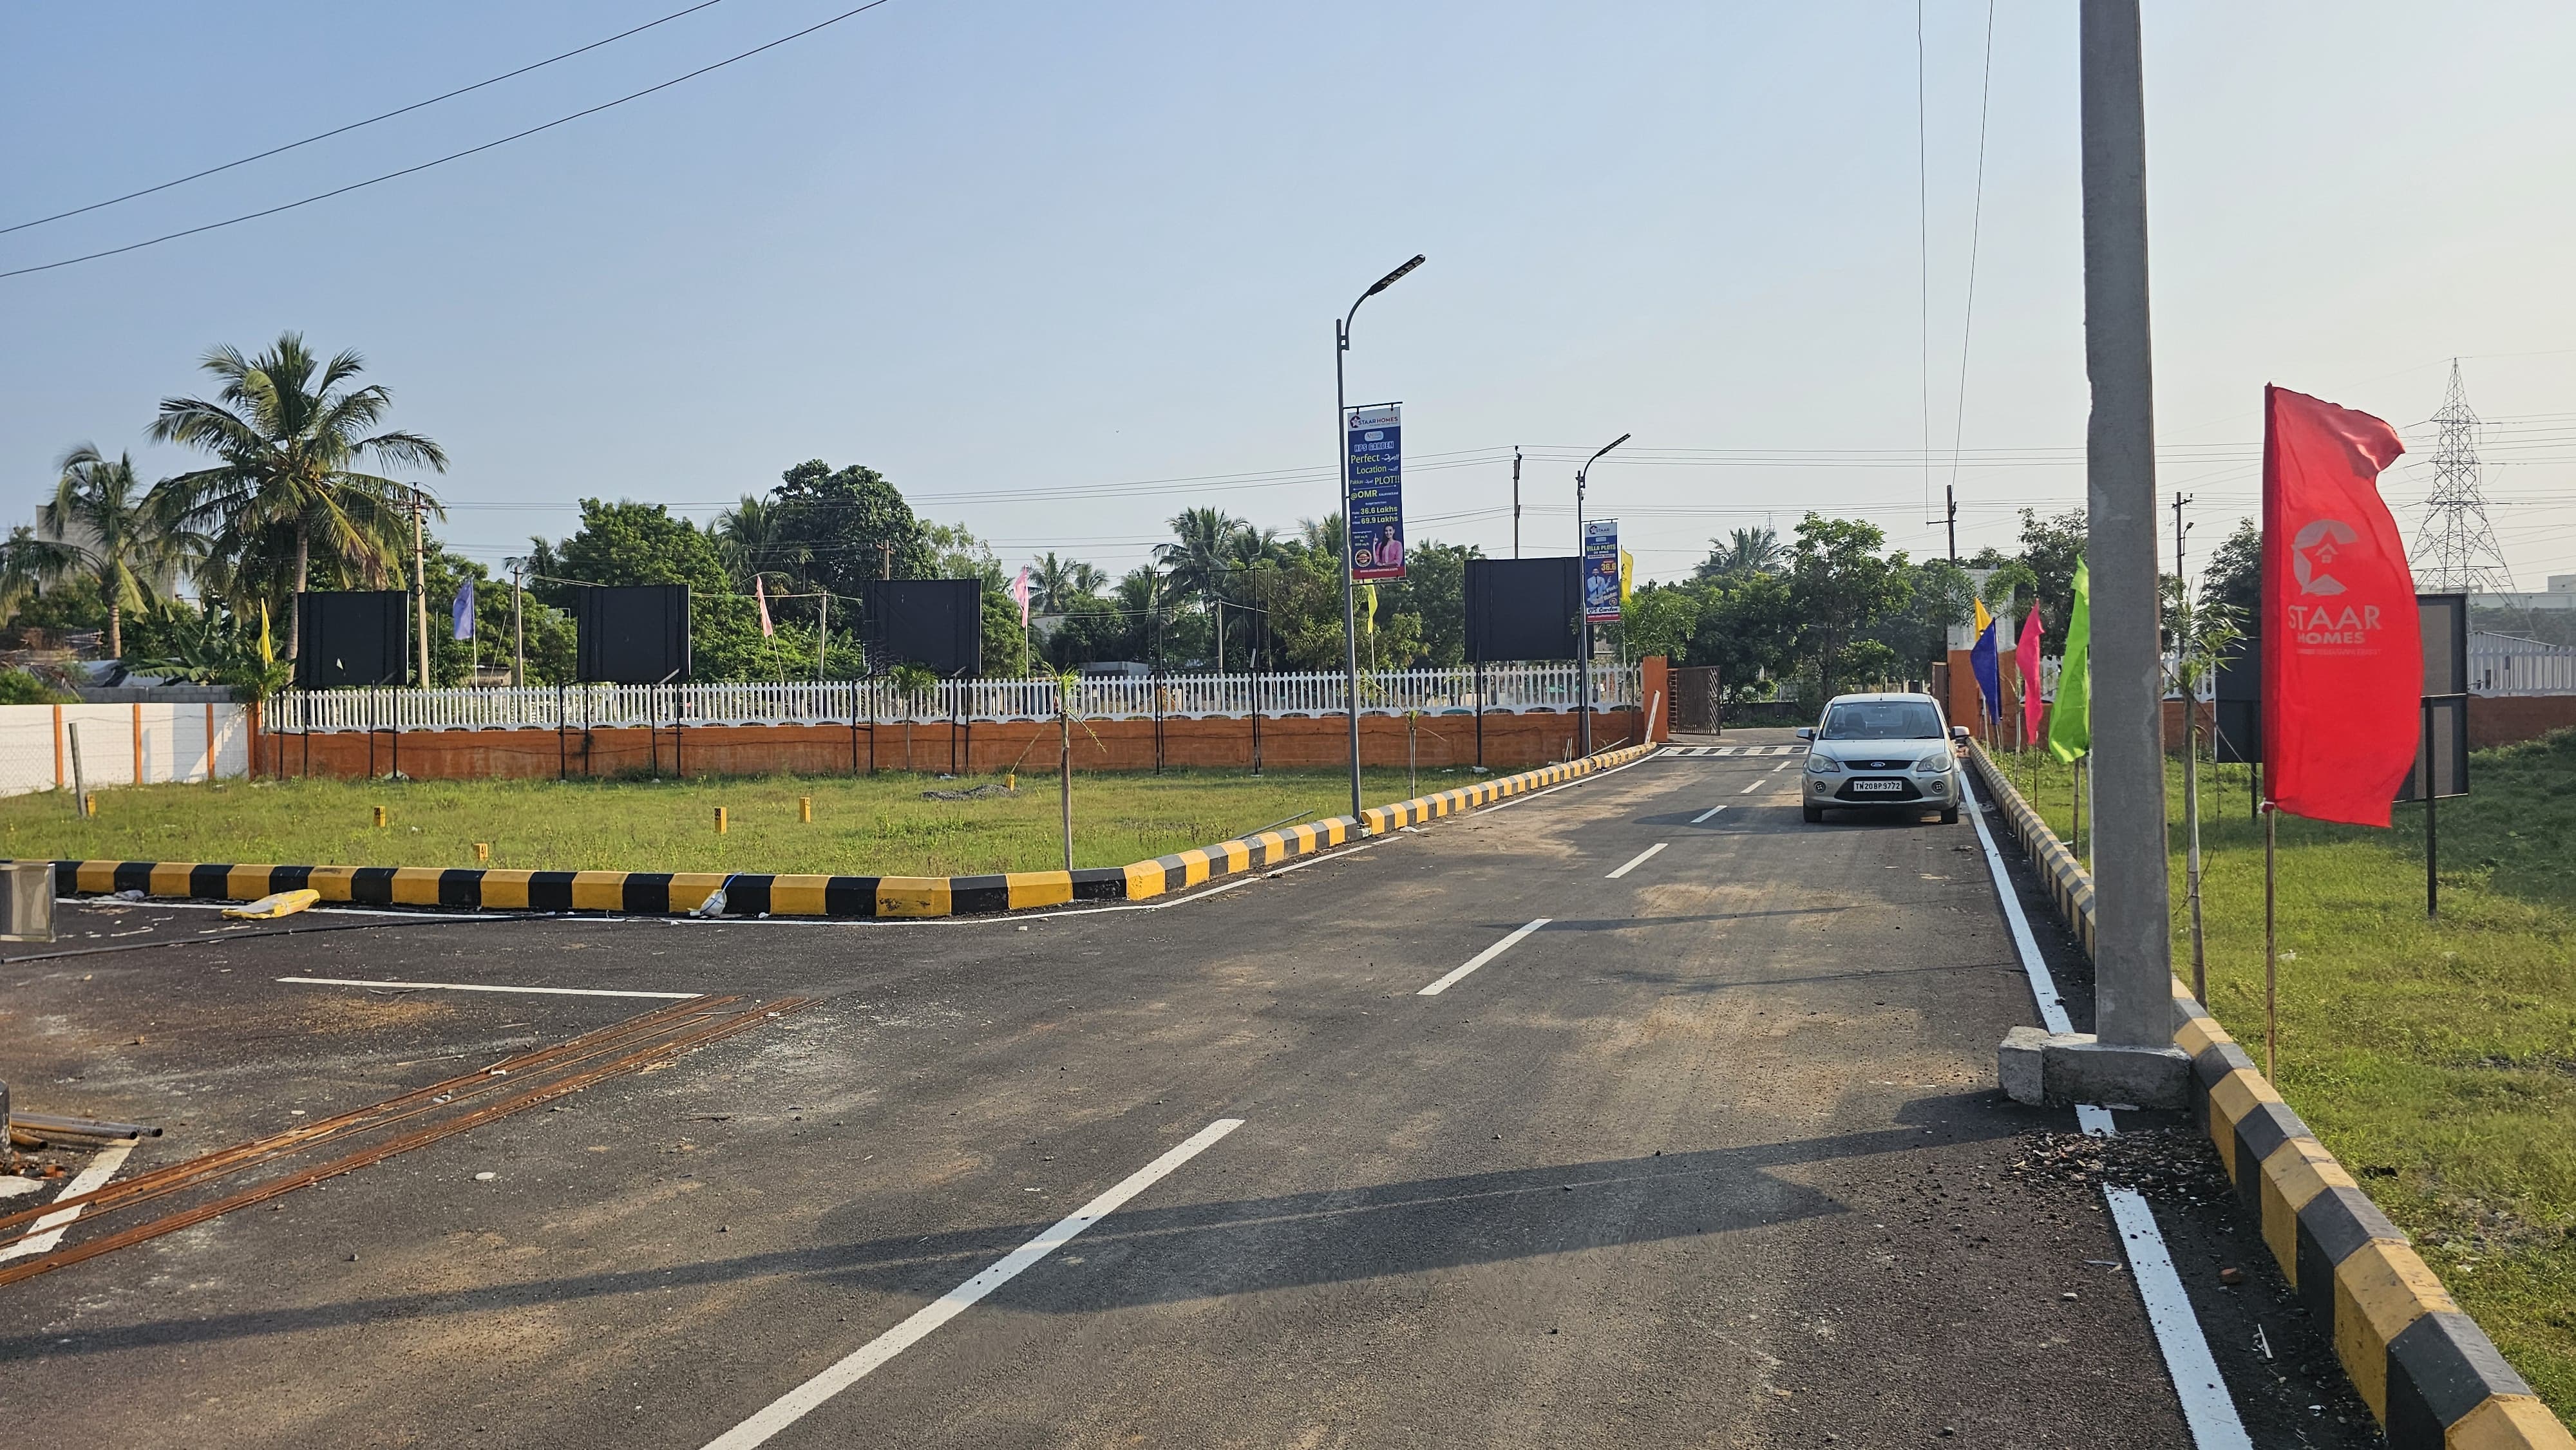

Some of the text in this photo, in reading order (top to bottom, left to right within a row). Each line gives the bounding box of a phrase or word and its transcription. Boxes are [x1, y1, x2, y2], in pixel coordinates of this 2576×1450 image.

[1368, 441, 1394, 451] GARDEN
[1350, 453, 1380, 464] Perfect
[1356, 465, 1387, 475] Location
[1374, 475, 1400, 485] PLOT!!
[1350, 490, 1378, 500] @OMR
[2288, 605, 2382, 630] STAAR
[2297, 632, 2365, 644] HOMES
